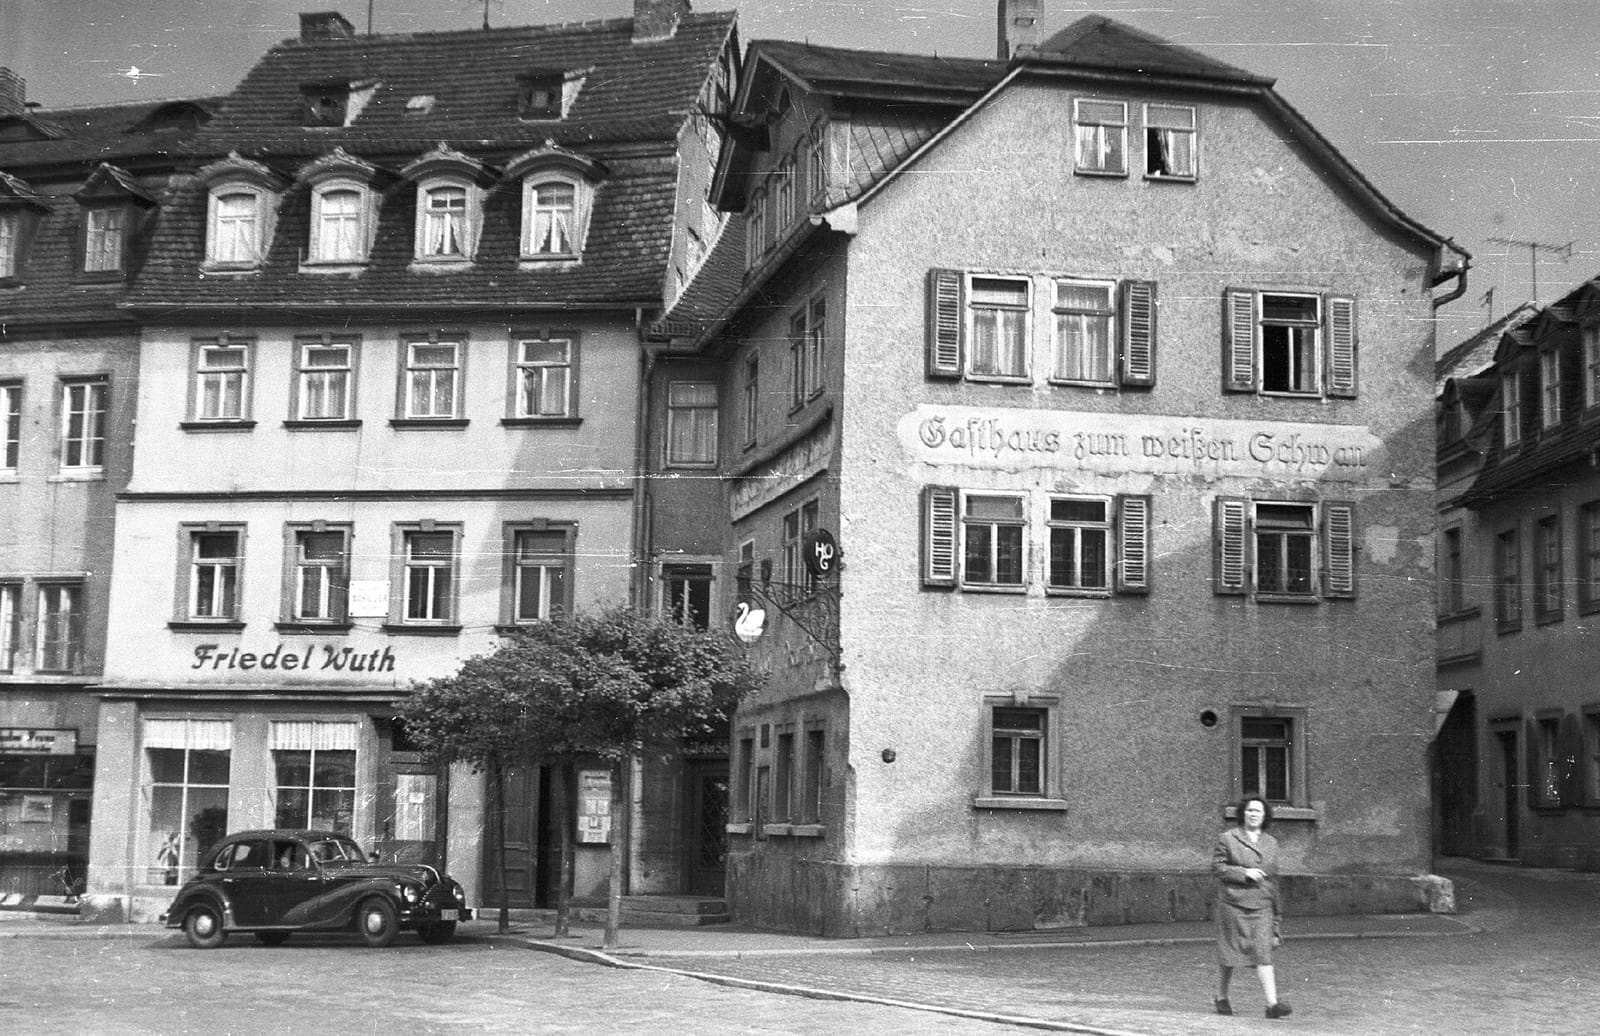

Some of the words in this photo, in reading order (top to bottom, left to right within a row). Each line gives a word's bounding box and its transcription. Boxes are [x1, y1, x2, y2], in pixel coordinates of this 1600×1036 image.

[1073, 431, 1129, 460] zum
[1141, 427, 1238, 468] weißen
[1249, 431, 1368, 472] Schwan
[191, 643, 315, 670] Friedel
[320, 644, 396, 672] Wuth
